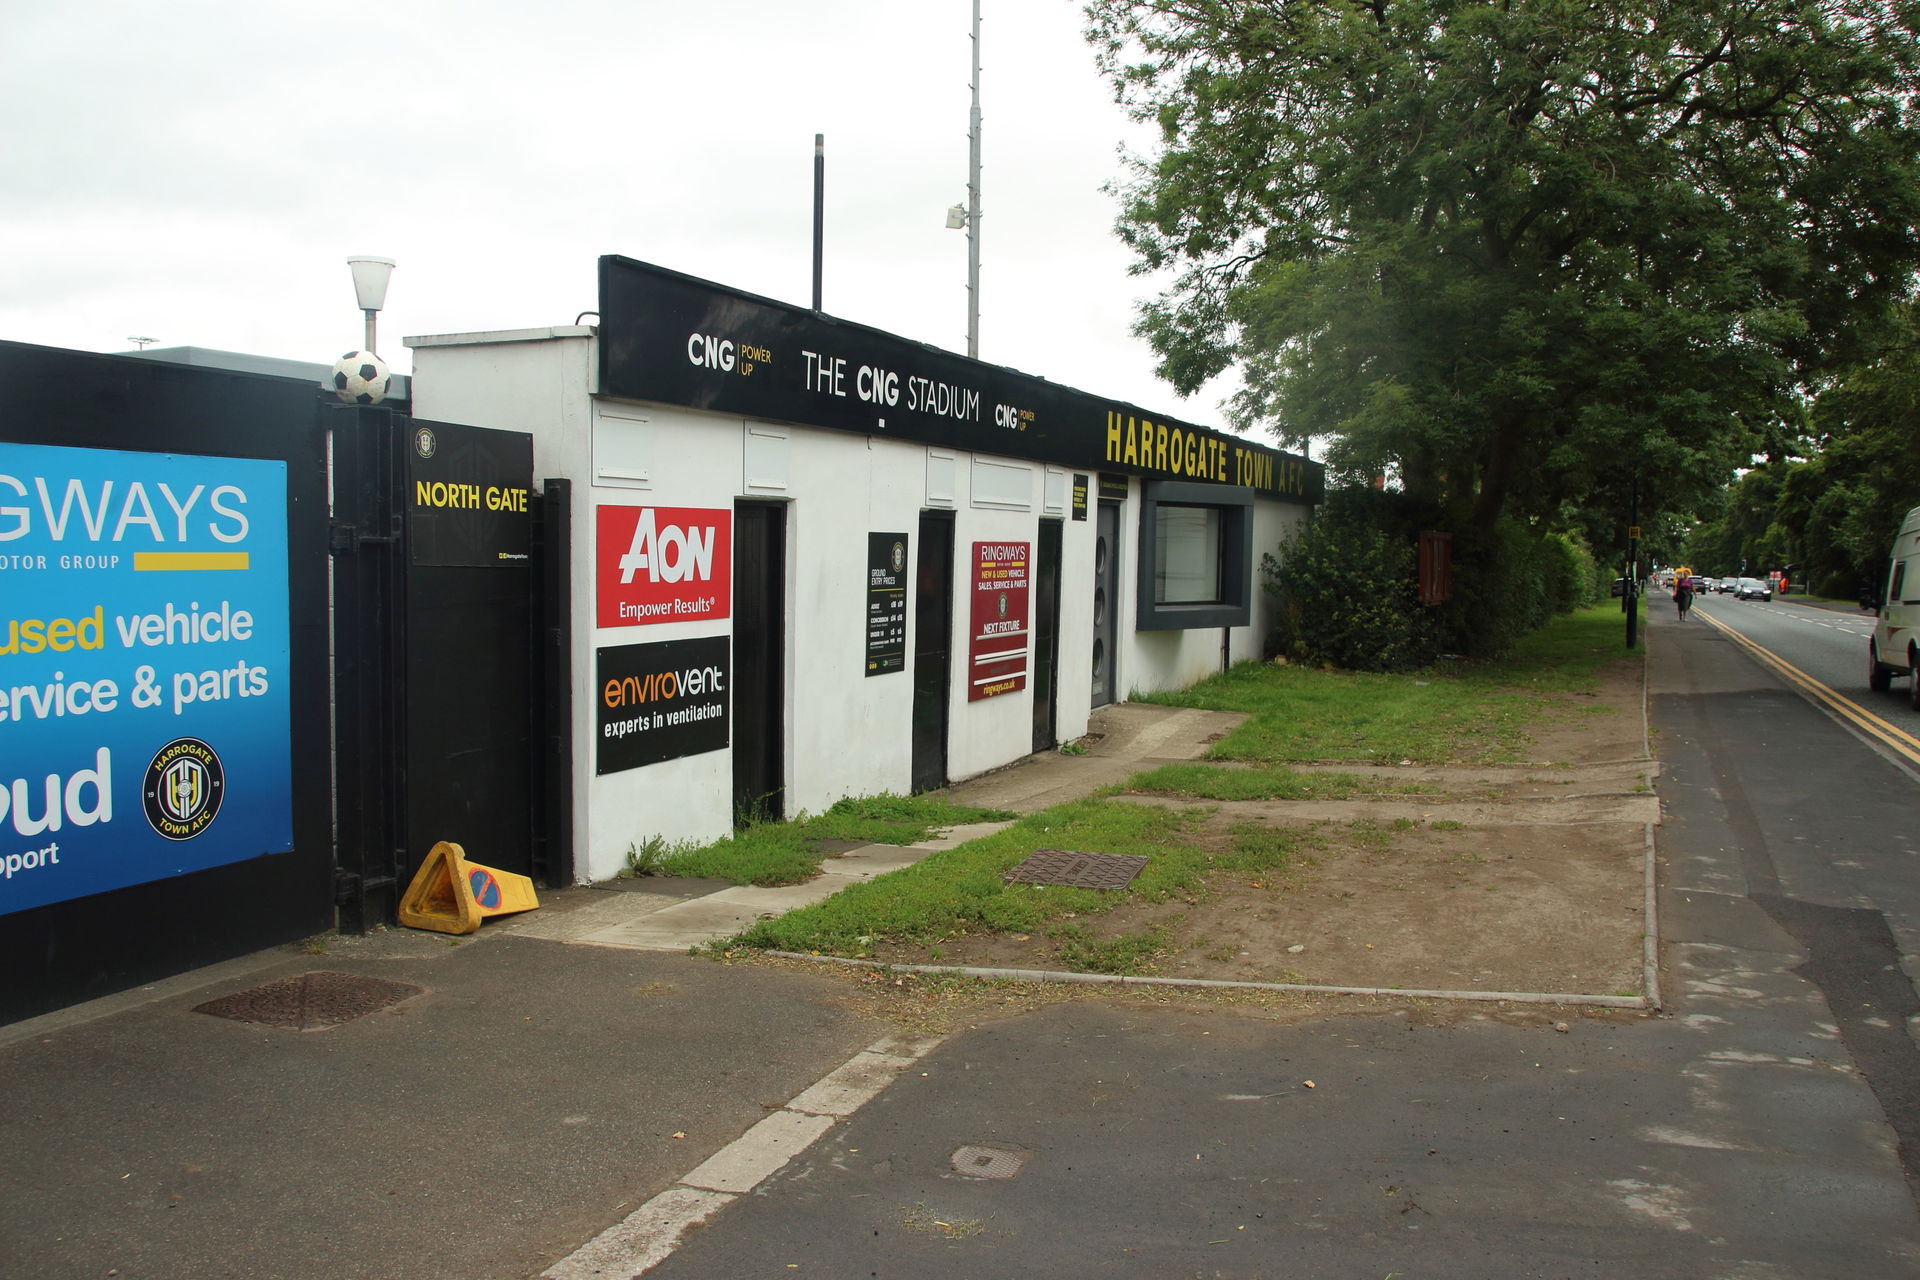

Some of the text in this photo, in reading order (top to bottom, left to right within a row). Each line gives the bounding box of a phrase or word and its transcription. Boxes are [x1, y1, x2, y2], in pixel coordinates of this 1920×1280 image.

[687, 332, 735, 372] CNG
[741, 344, 772, 364] POWER
[741, 363, 753, 377] UP
[801, 350, 980, 422] THE CNG STADIUM
[995, 403, 1018, 430] CNG
[1106, 410, 1304, 497] HARROGATE TOWN AFC
[416, 480, 528, 513] NORTH GATE
[60, 555, 120, 569] GROUP
[981, 545, 1026, 561] RINGWAYS
[1008, 569, 1025, 578] VEHICLE
[115, 600, 254, 648] vehicle
[619, 599, 672, 622] Empower
[983, 620, 1020, 635] NEXT FIXTURE
[131, 665, 162, 708] &
[173, 660, 268, 715] parts
[604, 665, 724, 709] envirovent
[983, 679, 1016, 697] ringways.co.uk
[604, 703, 723, 739] experts in ventilation
[154, 744, 213, 772] HARROGATE
[0, 746, 112, 837] ud
[159, 810, 211, 835] TOWN AFC
[0, 842, 60, 880] port
